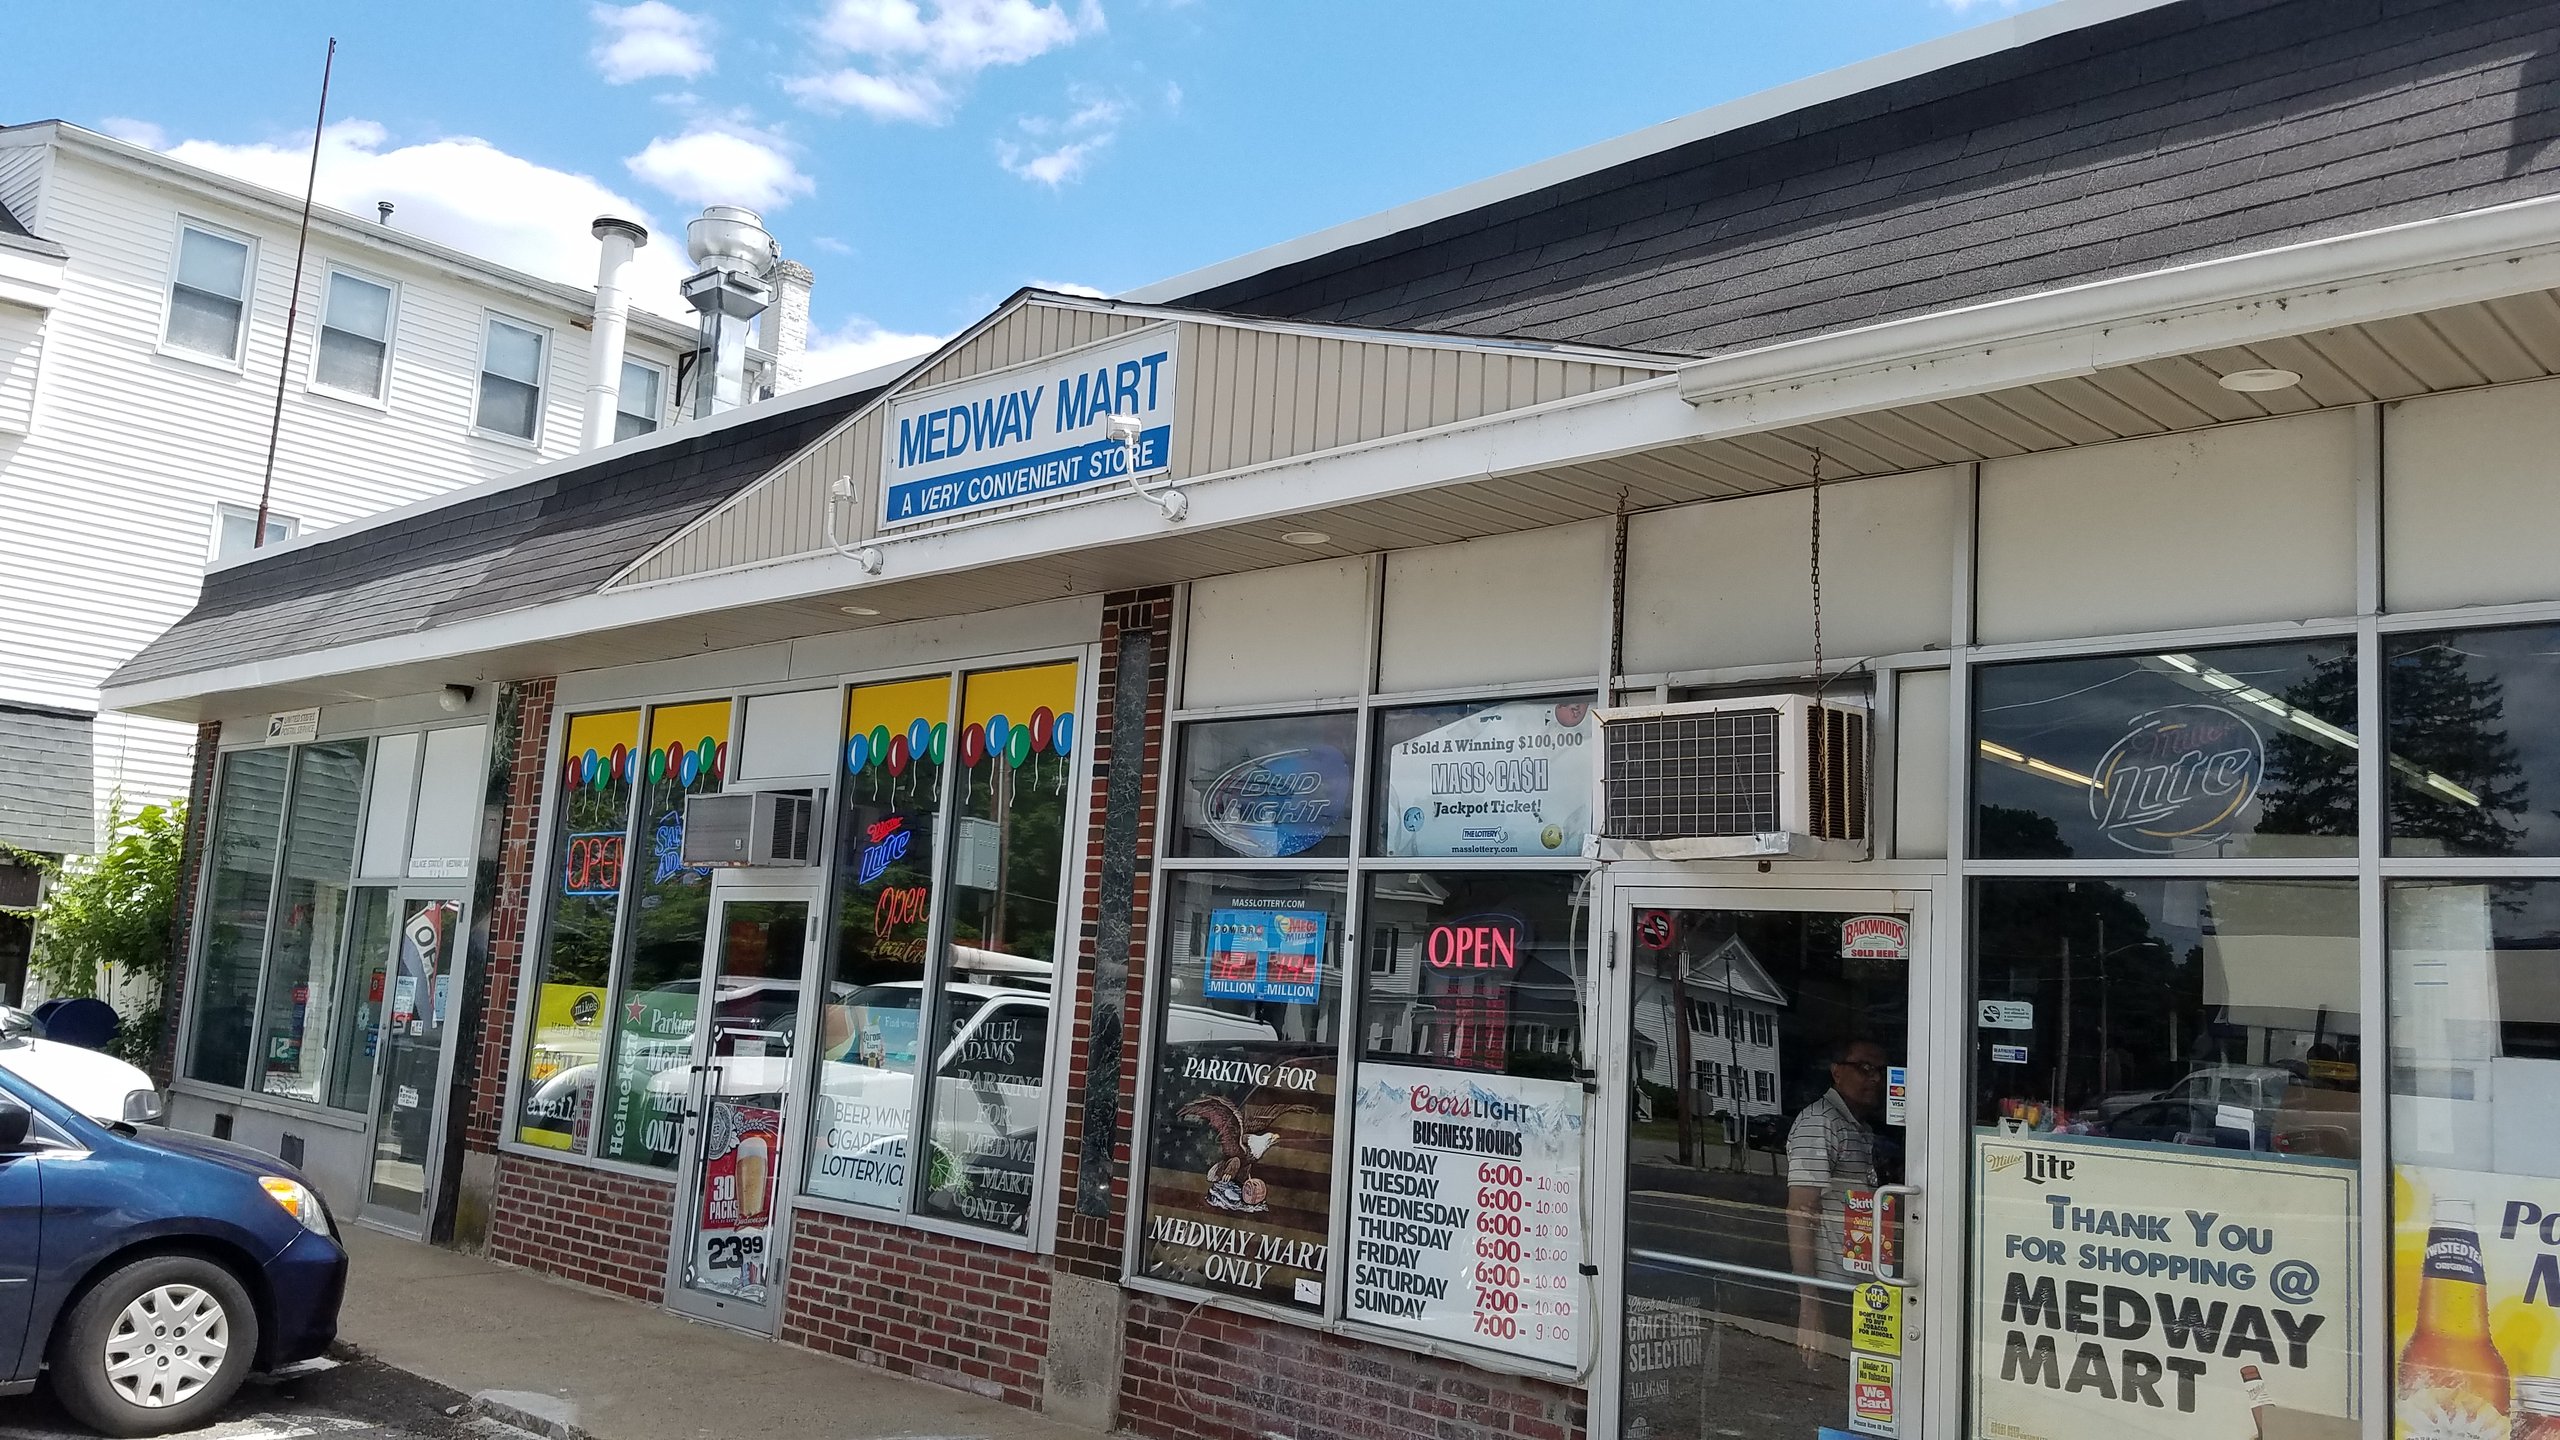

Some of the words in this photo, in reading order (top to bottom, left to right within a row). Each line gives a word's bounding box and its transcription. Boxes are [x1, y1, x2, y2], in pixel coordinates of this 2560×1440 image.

[898, 385, 1044, 469] MEDWAY
[1056, 351, 1168, 433] MART
[901, 492, 912, 516] A
[920, 483, 963, 512] VERY
[968, 456, 1083, 502] CONVENIENT
[1089, 439, 1154, 478] STORE
[1402, 743, 1408, 755] I
[1411, 741, 1439, 755] Sold
[1442, 740, 1453, 753] A
[1455, 738, 1514, 753] Winning
[1518, 733, 1583, 749] $100,000
[1241, 770, 1322, 797] BUD
[1431, 762, 1485, 795] MASS
[1220, 799, 1330, 824] LIGHT
[1433, 801, 1488, 818] Jackpot
[1491, 799, 1542, 814] Ticket!
[1451, 845, 1518, 855] masslottery.com
[874, 886, 930, 939] Open
[1231, 898, 1306, 909] MASSLOTTERY.COM
[1428, 926, 1516, 969] OPEN
[1844, 919, 1905, 947] BACKWOODS
[1851, 949, 1874, 958] SOLD
[1876, 949, 1900, 958] HERE
[1210, 980, 1256, 995] MILLION
[1266, 983, 1315, 998] MILLION
[650, 1008, 695, 1036] Parking
[951, 1018, 1024, 1045] SAMUEL
[953, 1041, 1016, 1066] ADAMS
[956, 1068, 1042, 1099] PARKING
[1183, 1057, 1271, 1086] PARKING
[1274, 1066, 1317, 1092] FOR
[609, 1029, 639, 1157] Heineken
[1410, 1084, 1472, 1118] Coors
[1473, 1098, 1529, 1123] LIGHT
[834, 1101, 872, 1128] BEER,
[975, 1102, 1013, 1128] FOR
[646, 1119, 684, 1155] ONLY
[964, 1132, 1036, 1164] MEDWA
[1412, 1120, 1474, 1152] BUSINESS
[1475, 1129, 1523, 1158] HOURS
[1361, 1146, 1439, 1175] MONDAY
[1478, 1162, 1522, 1188] 6:00
[1537, 1176, 1570, 1195] 10:00
[1985, 1154, 2022, 1172] Miller
[2023, 1151, 2075, 1185] Lite
[713, 1175, 736, 1202] 30
[1360, 1169, 1440, 1200] TUESDAY
[1477, 1187, 1522, 1213] 6:00
[1536, 1200, 1569, 1215] 10:00
[709, 1200, 740, 1220] PACKS
[961, 1195, 1015, 1226] ONLY
[1359, 1193, 1470, 1229] WEDNESDAY
[1476, 1211, 1521, 1238] 6:00
[1535, 1224, 1569, 1239] 10:00
[1849, 1197, 1889, 1212] Skitts
[1358, 1216, 1453, 1251] THURSDAY
[1475, 1236, 1521, 1263] 6:00
[1535, 1248, 1568, 1263] 10:00
[2045, 1194, 2172, 1244] THANK
[2185, 1209, 2274, 1256] YOU
[1149, 1215, 1256, 1259] MEDWAY
[1255, 1234, 1328, 1273] MART
[2426, 1241, 2469, 1260] TWISTED
[1205, 1254, 1272, 1291] ONLY
[1357, 1240, 1421, 1270] FRIDAY
[1475, 1261, 1520, 1289] 6:00
[1535, 1274, 1567, 1290] 10:00
[2005, 1234, 2067, 1266] FOR
[2079, 1243, 2257, 1290] SHOPPING
[2269, 1260, 2321, 1304] @
[2434, 1262, 2475, 1274] ORIGINAL
[1355, 1263, 1449, 1300] SATURDAY
[1475, 1285, 1519, 1314] 7:00
[1535, 1301, 1571, 1317] 10:00
[1865, 1293, 1889, 1304] YOUR
[1354, 1287, 1427, 1321] SUNDAY
[1473, 1310, 1517, 1340] 7:00
[1536, 1323, 1570, 1341] 9:00
[1628, 1313, 1670, 1342] CRAFT
[1670, 1310, 1702, 1338] BEER
[2000, 1272, 2326, 1370] MEDWAY
[1629, 1337, 1702, 1374] SELECTION
[1862, 1361, 1880, 1371] Under
[1881, 1364, 1888, 1373] 21
[1859, 1370, 1867, 1379] No
[2000, 1331, 2208, 1414] MART
[1630, 1380, 1669, 1399] ALLAGASH
[1857, 1396, 1891, 1410] Card
[1862, 1386, 1886, 1398] We
